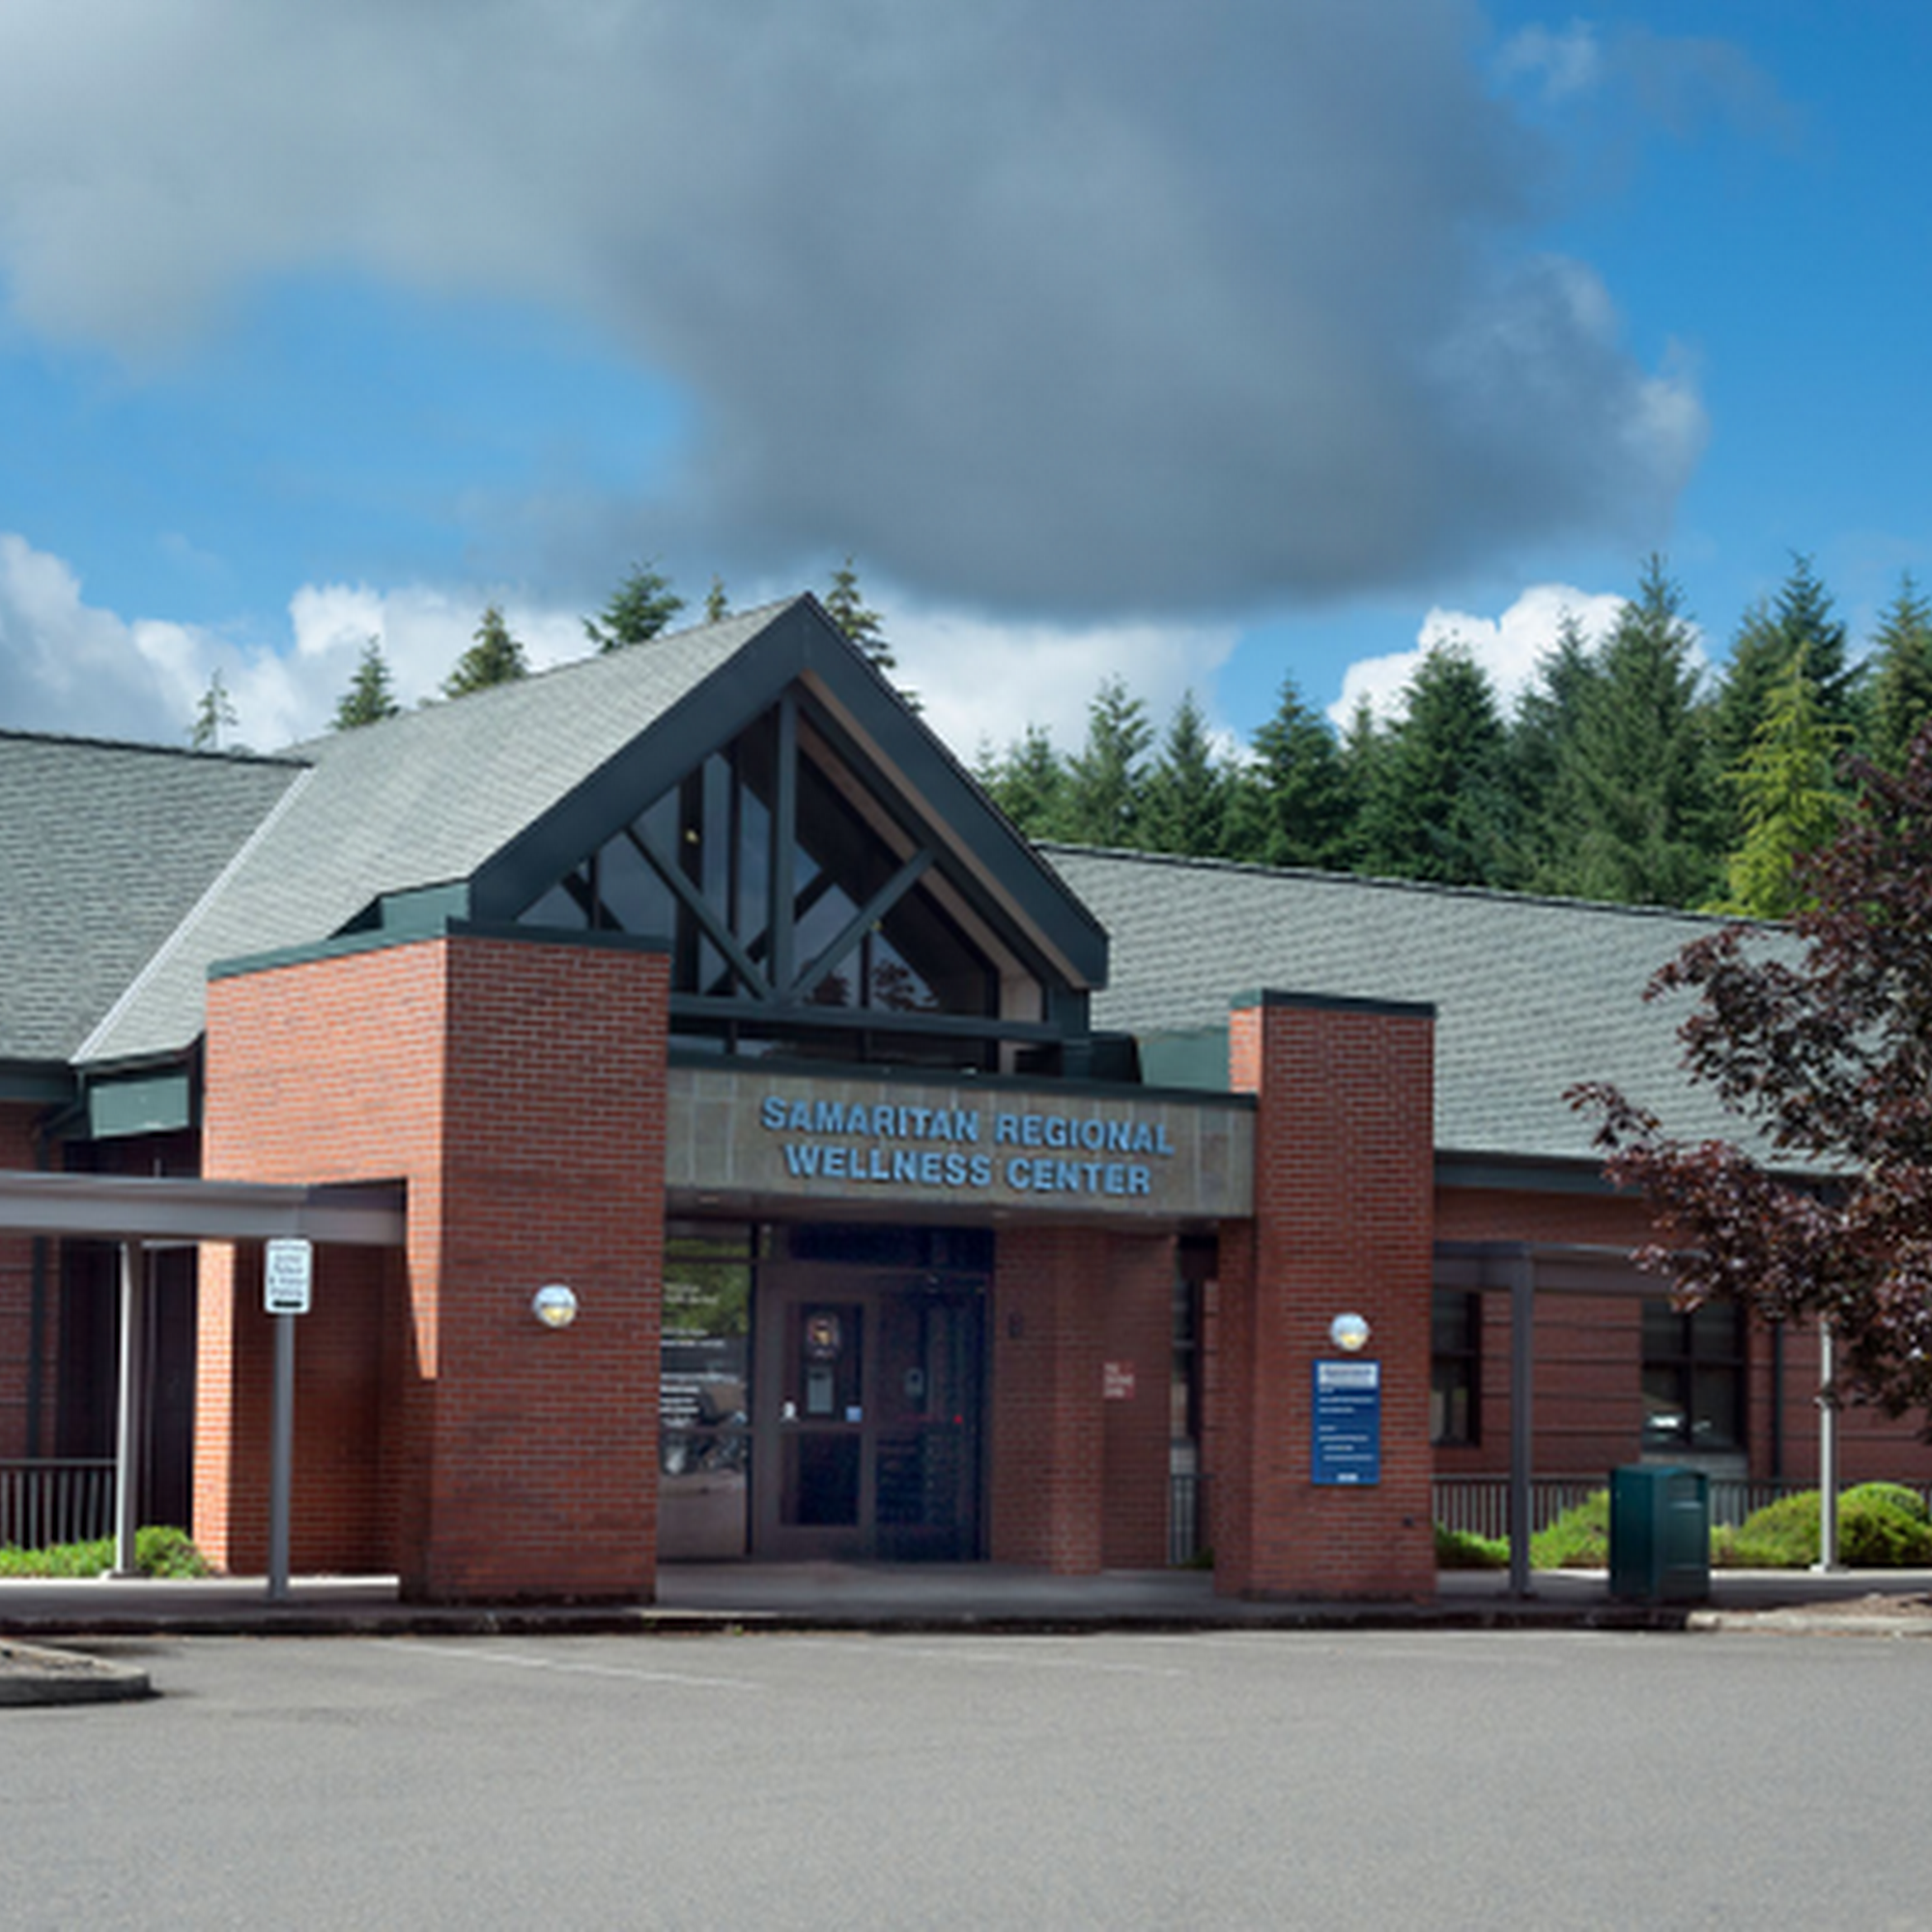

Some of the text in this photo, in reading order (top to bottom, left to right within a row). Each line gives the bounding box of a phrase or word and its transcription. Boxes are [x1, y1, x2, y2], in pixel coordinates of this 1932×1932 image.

[760, 1095, 1175, 1155] SAMARITAN REGIONAL
[783, 1143, 1152, 1195] WELLNESS CENTER
